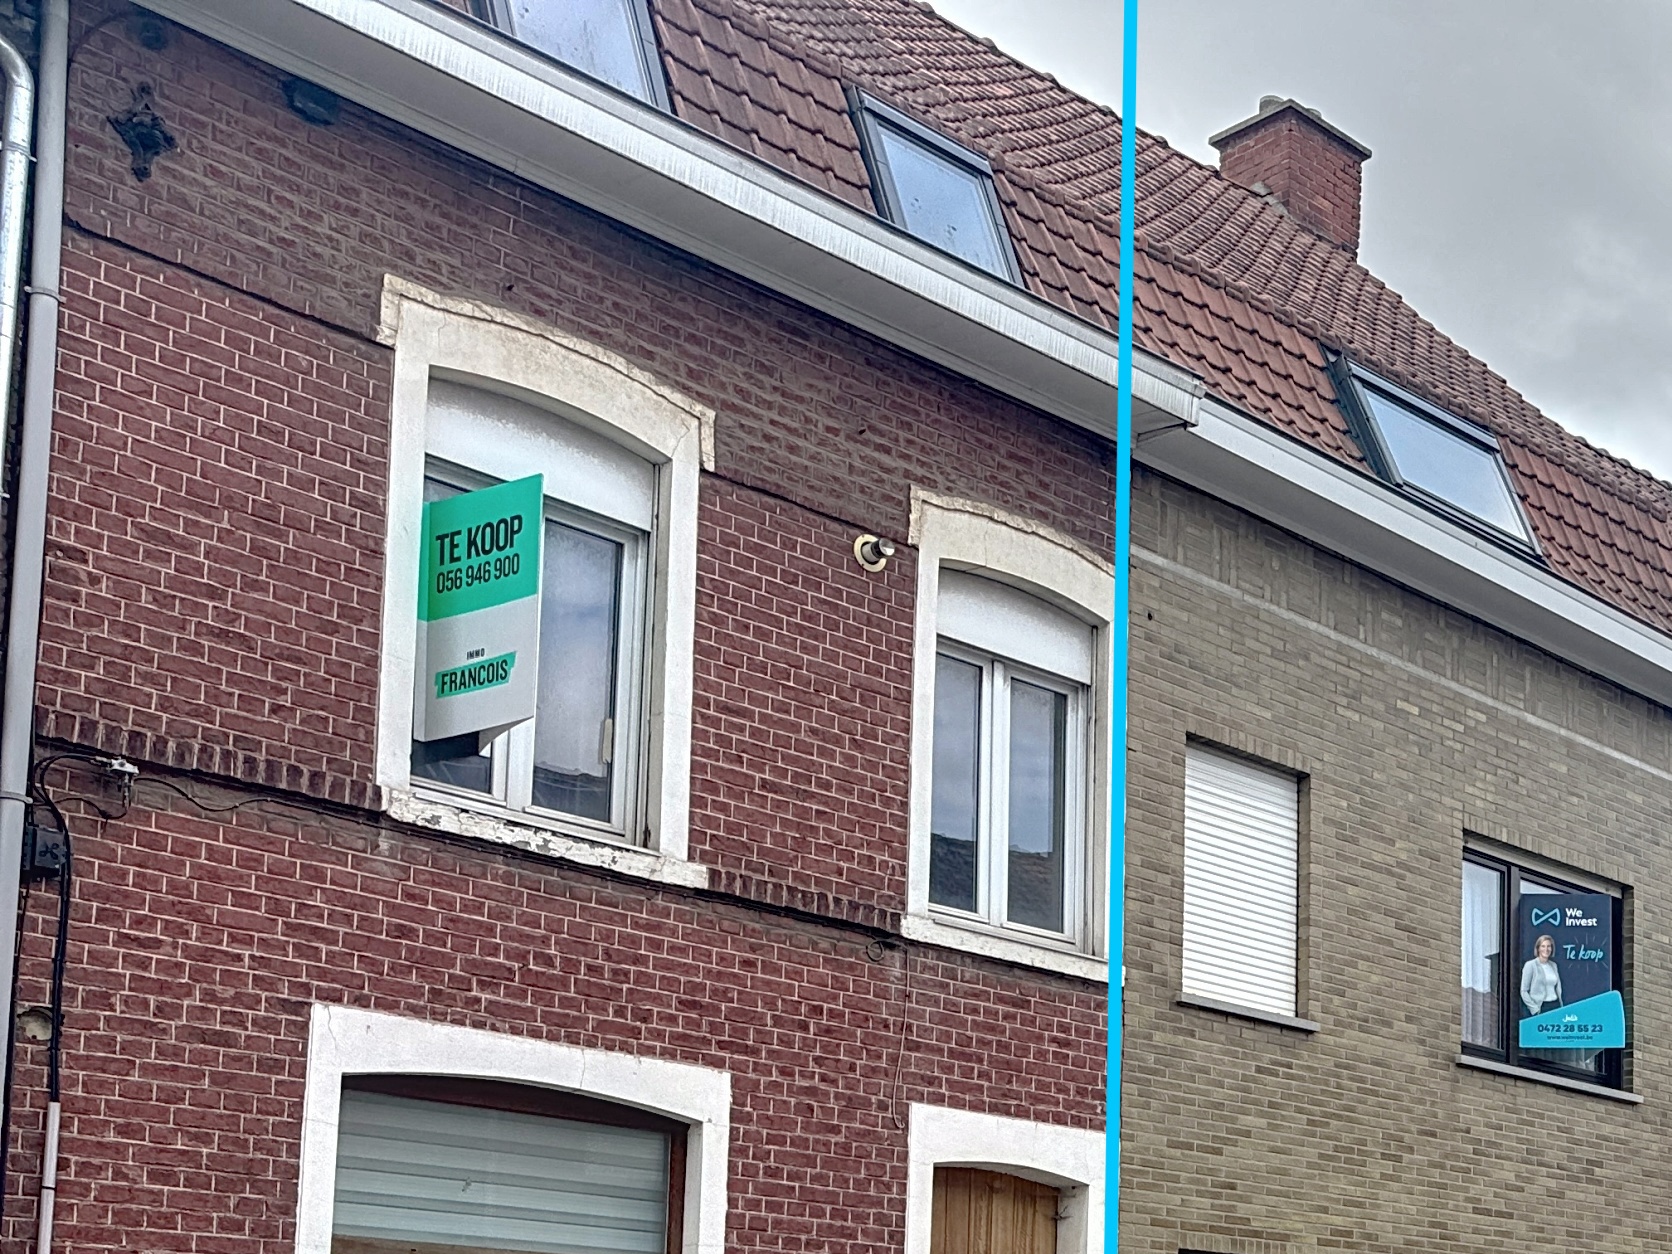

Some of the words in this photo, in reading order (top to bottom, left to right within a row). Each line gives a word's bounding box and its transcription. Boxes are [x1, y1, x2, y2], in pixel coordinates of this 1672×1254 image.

[436, 530, 462, 566] TE
[466, 514, 523, 560] KOOP
[436, 568, 463, 594] 056
[466, 561, 491, 587] 946
[494, 553, 520, 580] 900
[466, 648, 485, 660] IMMO
[441, 659, 508, 694] FRANCOIS
[1565, 908, 1583, 917] We
[1565, 917, 1598, 926] Invest
[1563, 944, 1576, 960] Te
[1578, 944, 1604, 963] koop
[1537, 1024, 1561, 1032] 0472
[1563, 1024, 1575, 1032] 28
[1591, 1024, 1603, 1032] 23
